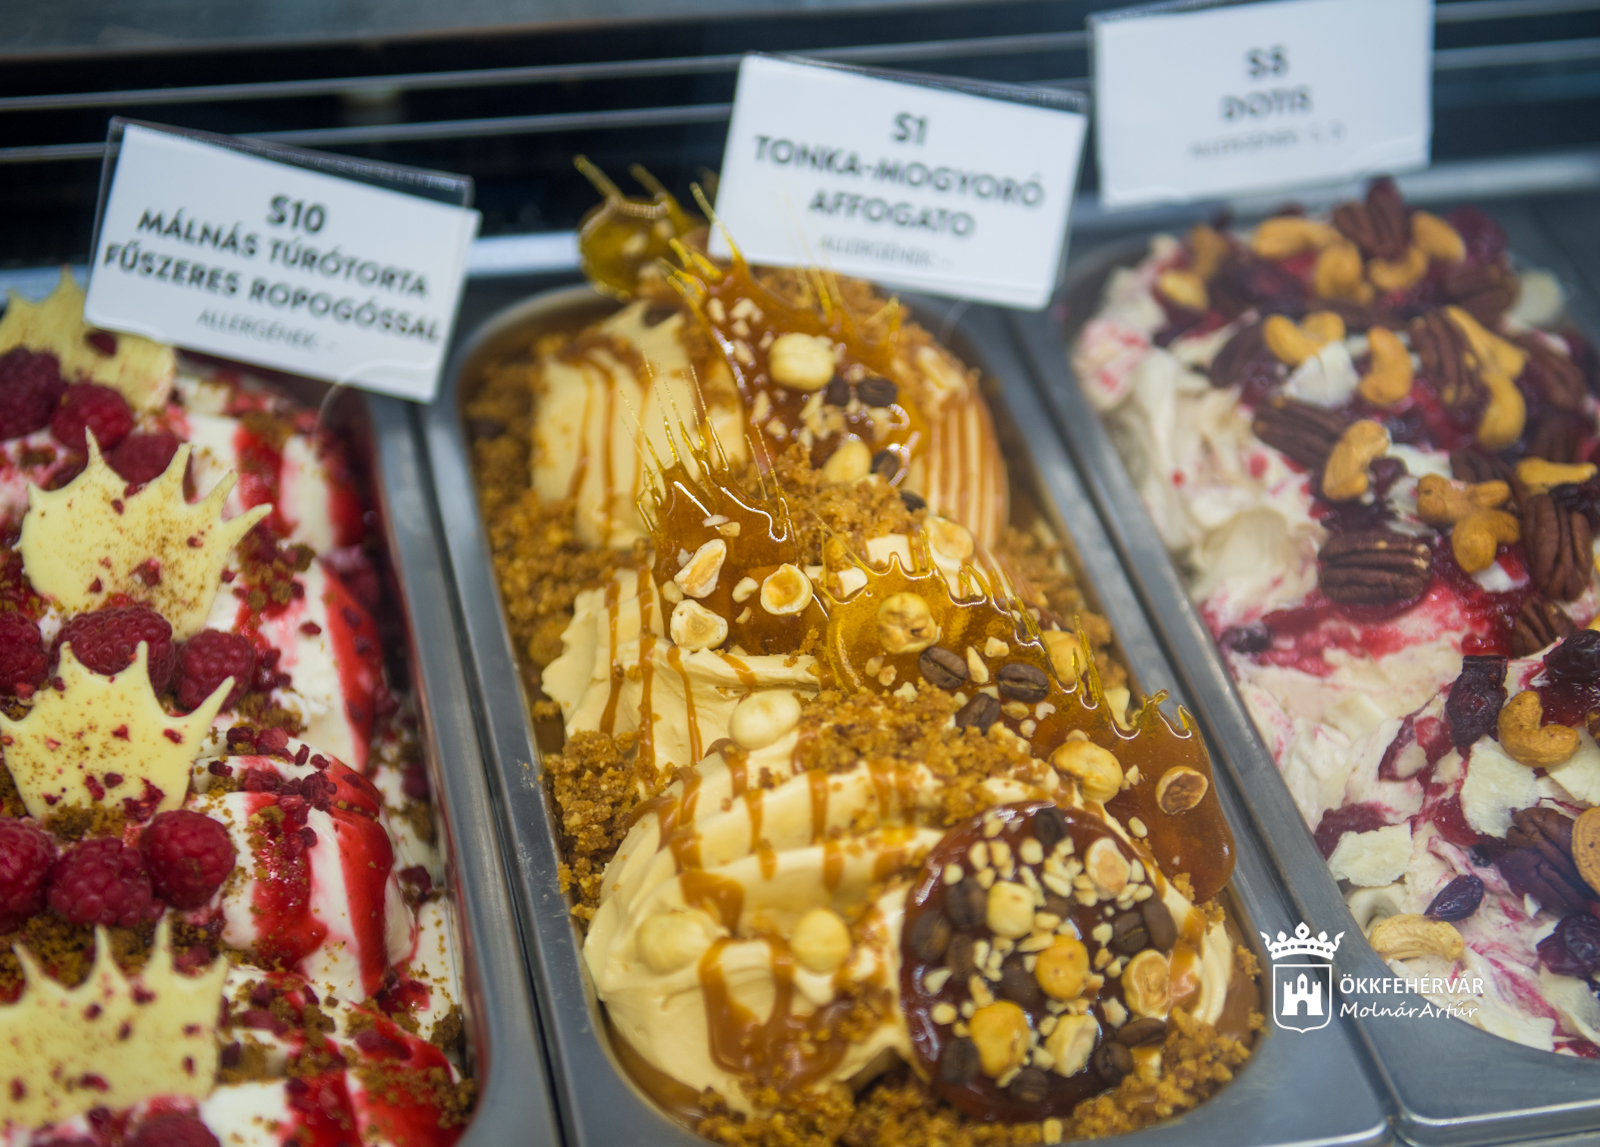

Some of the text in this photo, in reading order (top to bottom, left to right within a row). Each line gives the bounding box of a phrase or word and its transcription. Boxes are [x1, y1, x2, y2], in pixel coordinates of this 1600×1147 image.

[892, 112, 928, 144] S1
[755, 136, 1045, 207] TONKA-MOGYORÓ
[267, 194, 326, 232] S10
[810, 190, 975, 236] AFFOGATO
[137, 208, 428, 297] MÁLNÁS TÚRÓTORTA
[104, 241, 439, 342] FŰSZERES ROPOGÓSSAL
